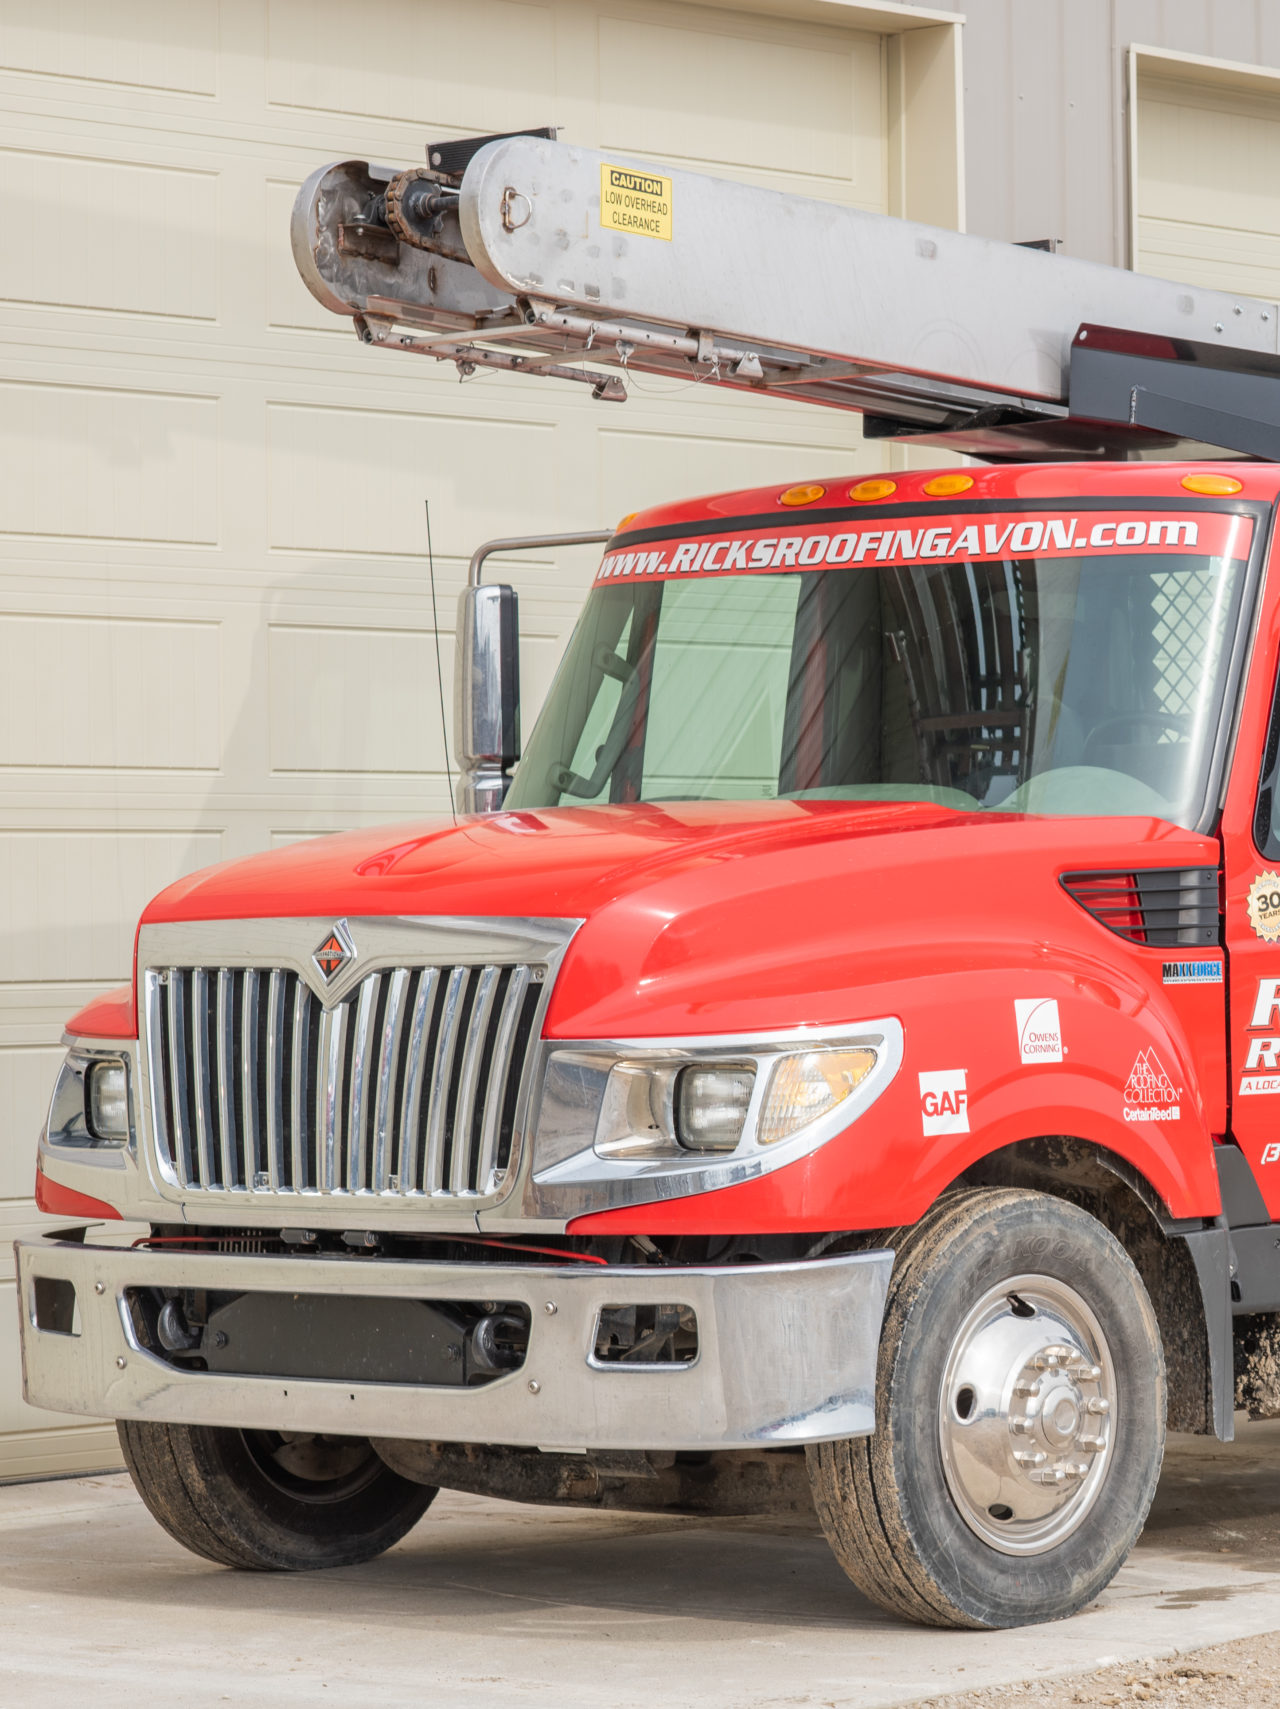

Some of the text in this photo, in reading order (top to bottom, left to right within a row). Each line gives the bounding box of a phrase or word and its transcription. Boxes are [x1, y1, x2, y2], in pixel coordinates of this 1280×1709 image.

[612, 172, 661, 194] CAUTION
[605, 190, 668, 216] LOW OVERHEAD
[612, 211, 660, 233] CLEARANCE
[1162, 961, 1222, 978] MAXXFORCE
[1029, 1032, 1059, 1043] OWENS
[1023, 1043, 1060, 1055] CORNING
[1136, 1063, 1149, 1075] THE
[1131, 1074, 1167, 1089] ROOFING
[1243, 1079, 1253, 1091] A
[921, 1090, 968, 1117] GAF
[1124, 1087, 1180, 1104] COLLECTION
[1123, 1106, 1172, 1121] CertainTeed
